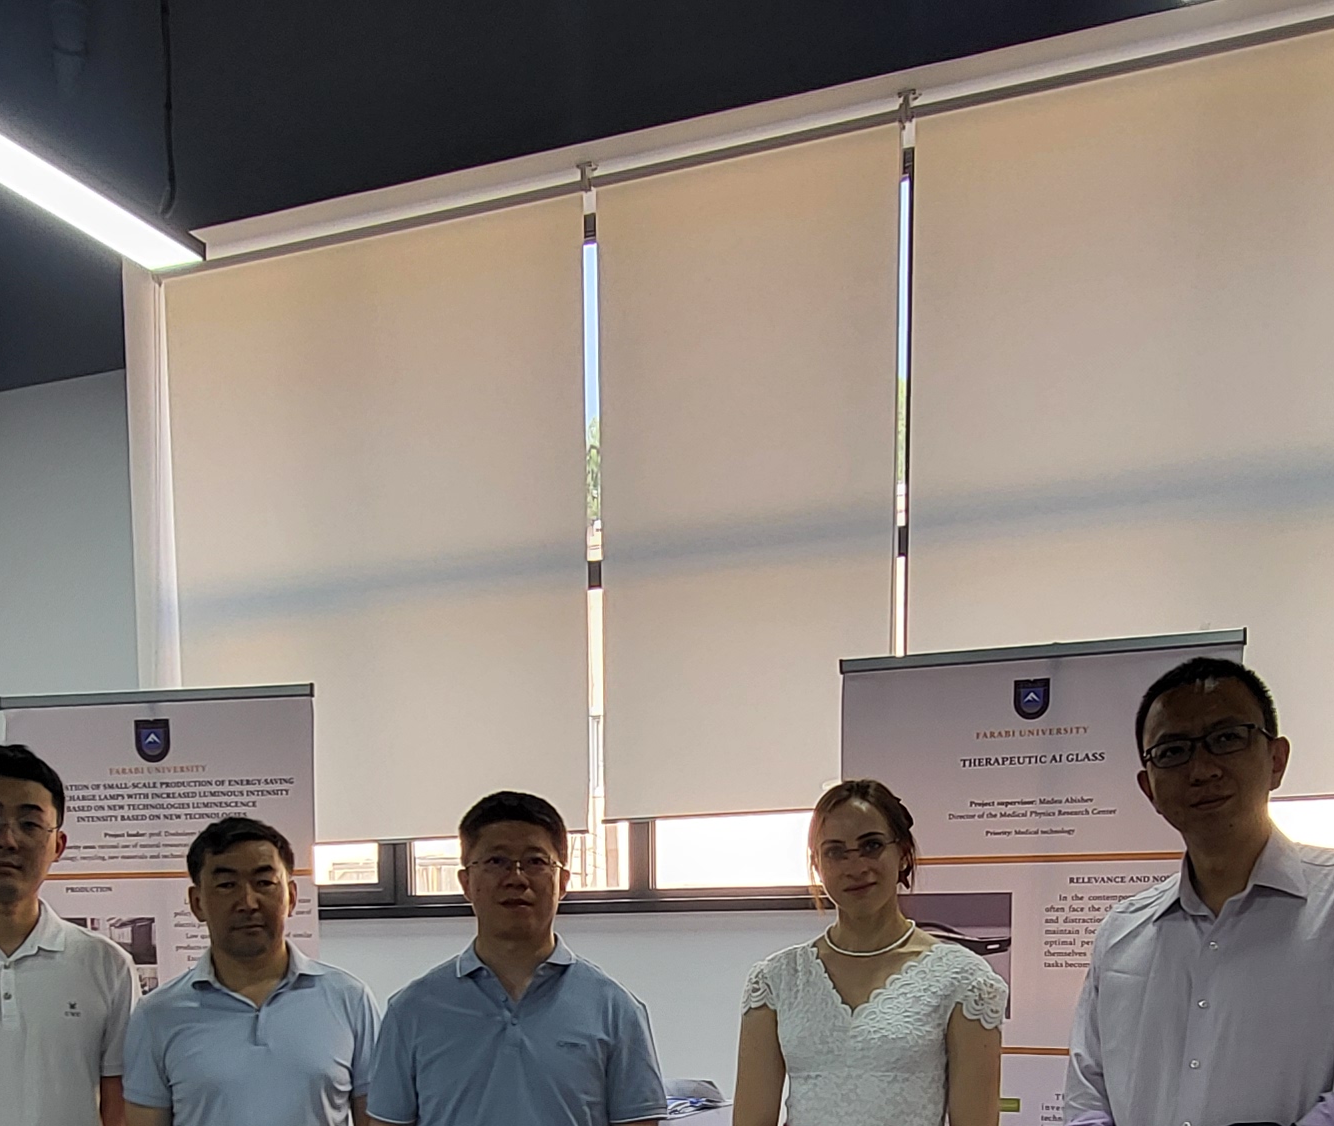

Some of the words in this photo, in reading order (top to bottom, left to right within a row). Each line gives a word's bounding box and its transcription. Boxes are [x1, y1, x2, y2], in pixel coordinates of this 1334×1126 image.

[976, 730, 1015, 740] FARABI
[1019, 726, 1089, 738] UNIVERSITY
[960, 754, 1047, 768] THERAPEUTIC
[1049, 754, 1063, 764] AI
[1066, 752, 1105, 763] GLASS
[109, 766, 144, 776] FARABI
[147, 764, 207, 774] UNIVERSITY
[91, 782, 101, 791] OF
[103, 782, 157, 791] SMALL-SCALE
[159, 780, 213, 789] PRODUCTION
[215, 779, 226, 788] OF
[98, 792, 125, 801] LAMPS
[127, 792, 149, 801] WITH
[151, 791, 197, 800] INCREASED
[198, 790, 244, 799] LUMINOUS
[246, 788, 290, 798] INTENSITY
[67, 804, 93, 813] BASED
[94, 804, 105, 812] ON
[107, 803, 125, 812] NEW
[127, 802, 190, 811] TECHNOLOGIES
[191, 800, 257, 810] LUMINESCENCE
[969, 800, 995, 808] Project
[77, 814, 118, 823] INTENSITY
[120, 814, 147, 822] BASED
[148, 813, 161, 821] ON
[163, 812, 181, 821] NEW
[999, 810, 1027, 818] Medical
[1029, 810, 1055, 819] Physics
[1058, 808, 1089, 816] Research
[1014, 828, 1039, 836] Medical
[1069, 876, 1126, 884] RELEVANCE
[66, 886, 113, 894] PRODUCTION
[1044, 916, 1059, 924] and
[1045, 927, 1080, 935] maintain
[1044, 938, 1076, 948] optimal
